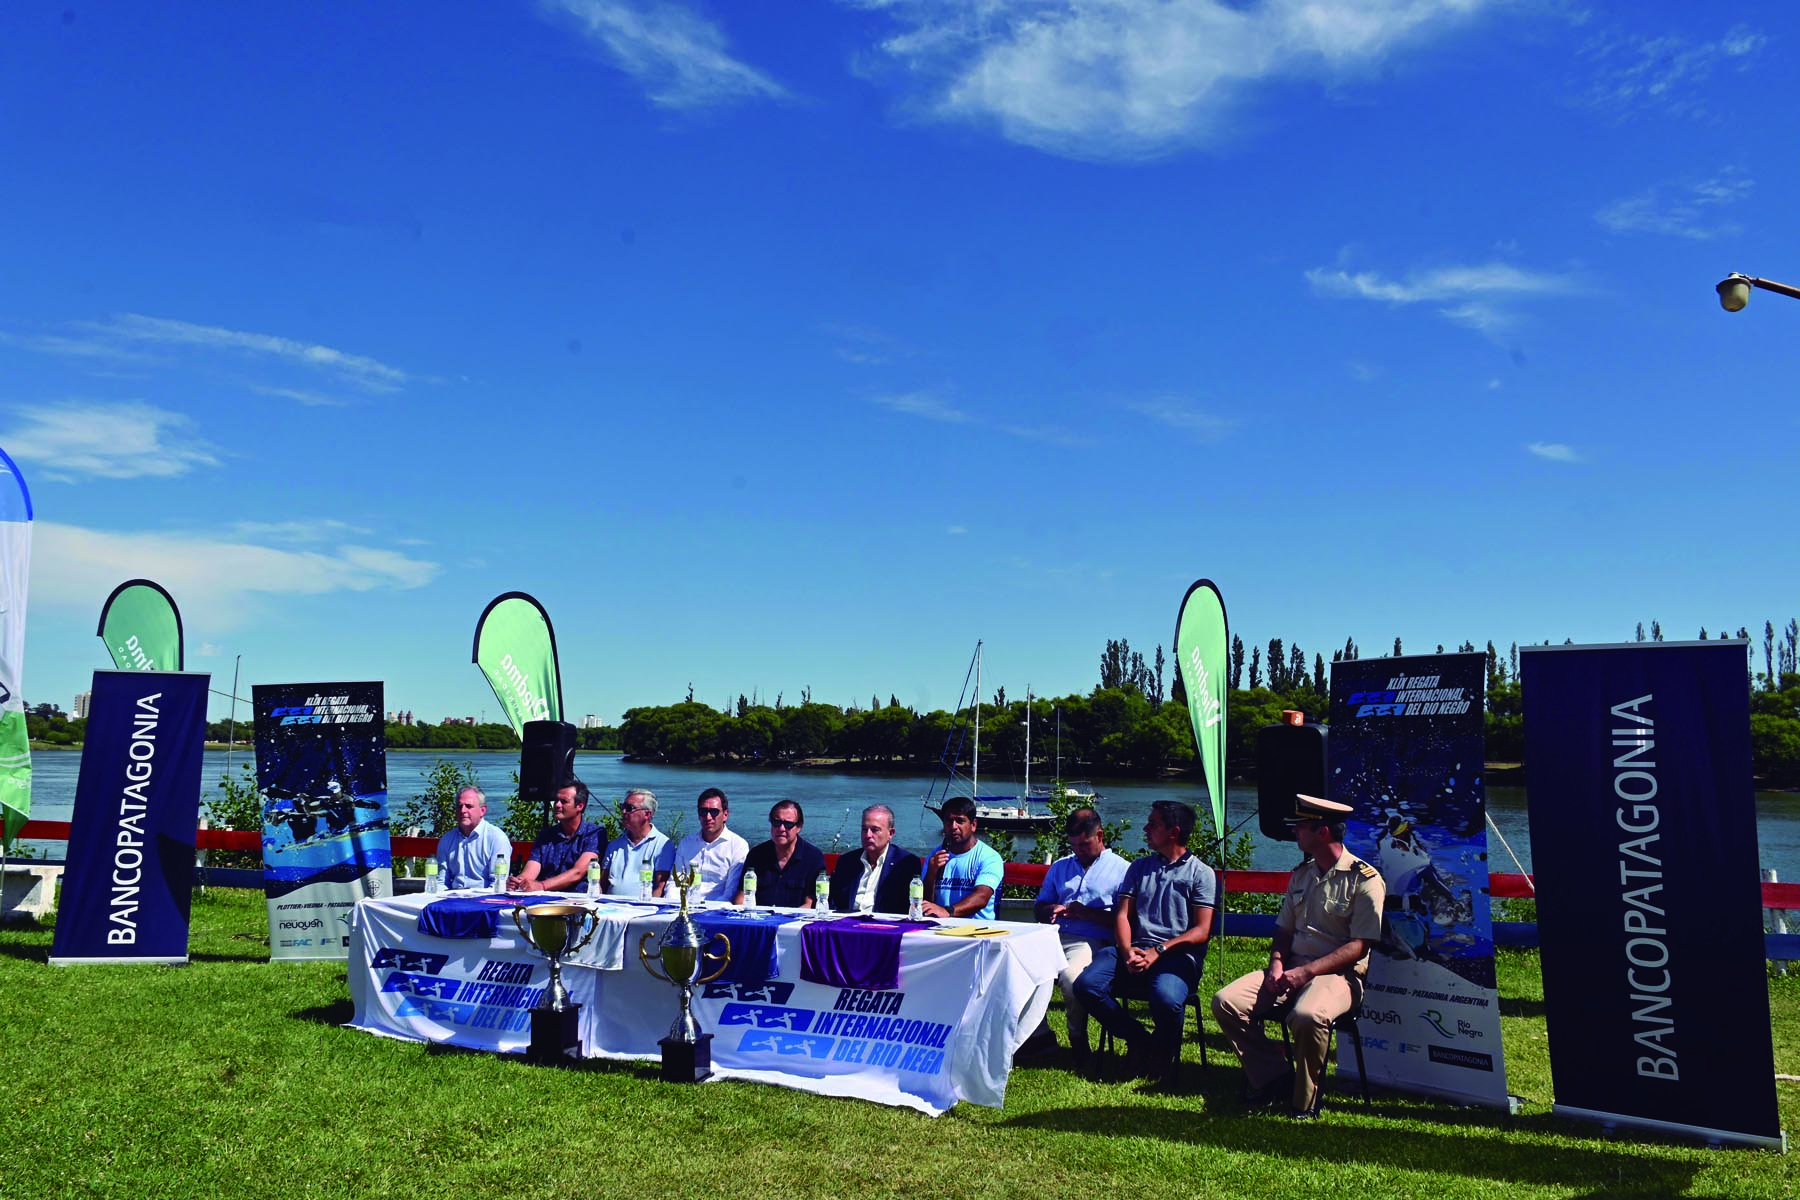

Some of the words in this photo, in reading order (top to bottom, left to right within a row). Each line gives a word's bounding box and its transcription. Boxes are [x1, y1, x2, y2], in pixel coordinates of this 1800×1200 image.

[1386, 677, 1408, 690] XLIX
[1406, 676, 1440, 690] REGATA
[320, 695, 350, 706] REGATA
[1395, 688, 1465, 703] INTERNACIONAL
[312, 705, 369, 715] INTERNACIONAL
[321, 714, 335, 724] DEL
[334, 714, 351, 724] RIO
[348, 713, 374, 723] NEGRO
[1404, 703, 1422, 716] DEL
[1420, 702, 1439, 715] RIO
[1437, 701, 1470, 715] NEGRO
[107, 692, 162, 945] BANCOPATAGONIA
[1610, 693, 1679, 1081] BANCOPATAGONIA
[477, 960, 535, 985] REGATA
[833, 988, 905, 1015] REGATA
[1385, 984, 1408, 996] NEGRO
[1412, 990, 1449, 1002] PATAGONIA
[1449, 994, 1489, 1007] ARGENTINA
[470, 1006, 501, 1029] DEL
[498, 1008, 530, 1033] RIO
[813, 1011, 952, 1049] INTERNACIONAL
[1457, 1027, 1483, 1039] Negro
[832, 1038, 869, 1064] DEL
[866, 1041, 904, 1068] RIO
[1432, 1050, 1489, 1067] BANCOPATAGONIA
